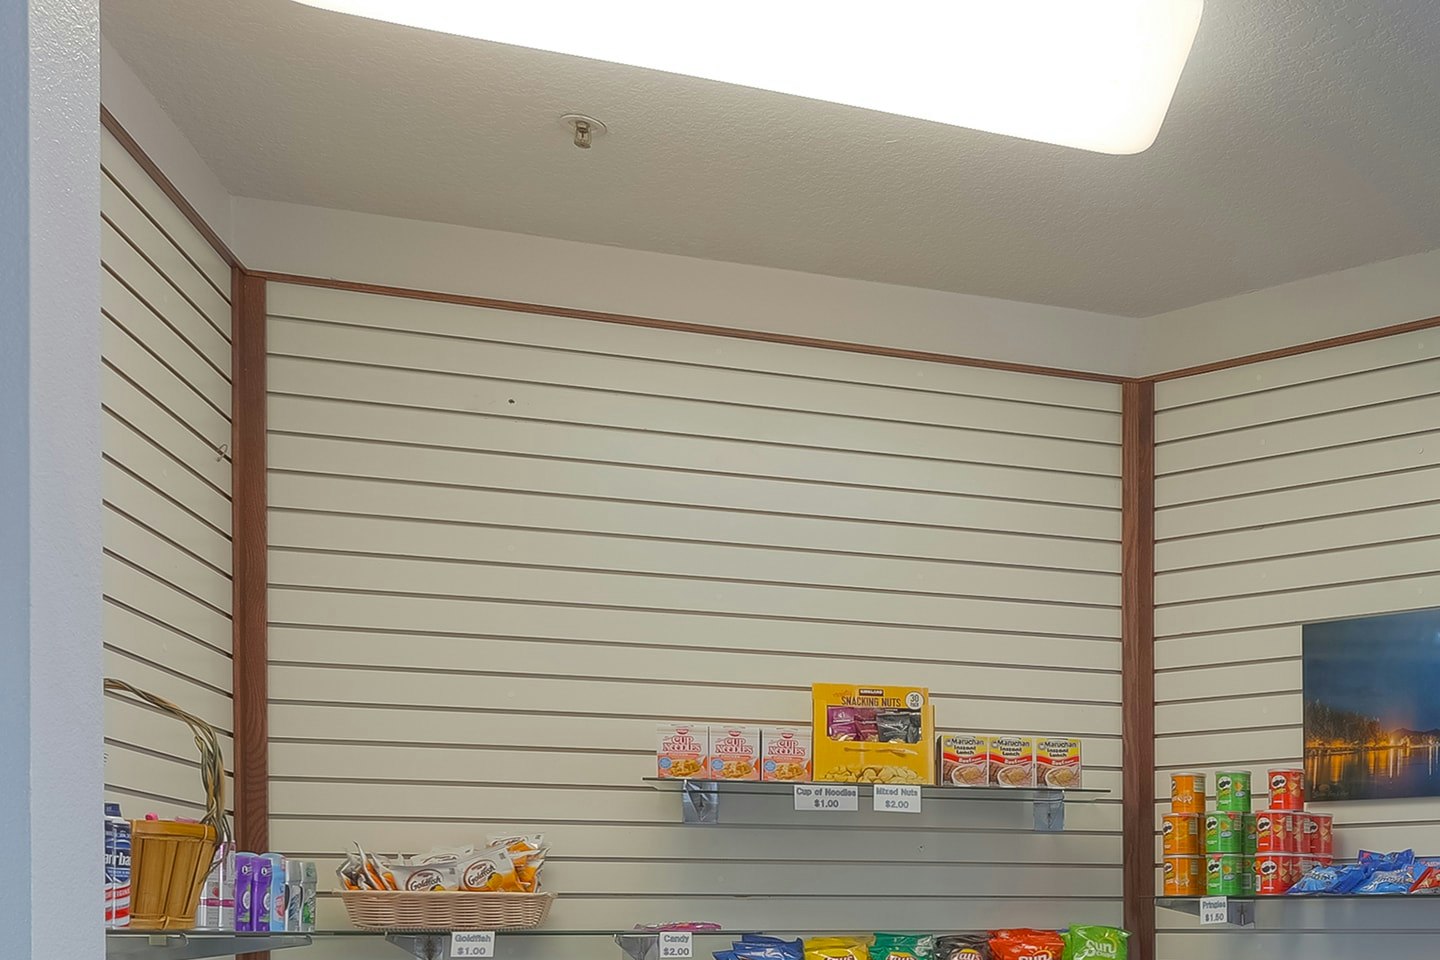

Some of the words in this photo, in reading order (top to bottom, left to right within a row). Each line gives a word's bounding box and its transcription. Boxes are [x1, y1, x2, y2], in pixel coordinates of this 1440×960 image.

[841, 696, 880, 707] SNACKING
[881, 698, 901, 707] NUTS
[951, 738, 985, 746] Maruchan
[998, 739, 1030, 747] Maruchan
[1044, 741, 1077, 749] Maruchan
[796, 787, 812, 796] Cup
[814, 788, 822, 796] of
[825, 788, 857, 797] Noodles
[876, 788, 898, 796] Mixed
[901, 788, 918, 796] Nuts
[814, 799, 839, 808] $1.00
[885, 800, 909, 809] $2.00
[1202, 901, 1226, 909] Pringles
[1205, 913, 1224, 922] $1.50
[454, 934, 491, 943] Goldfish
[664, 934, 689, 944] Candy
[457, 947, 486, 955] $1.00
[663, 947, 690, 956] $2.00
